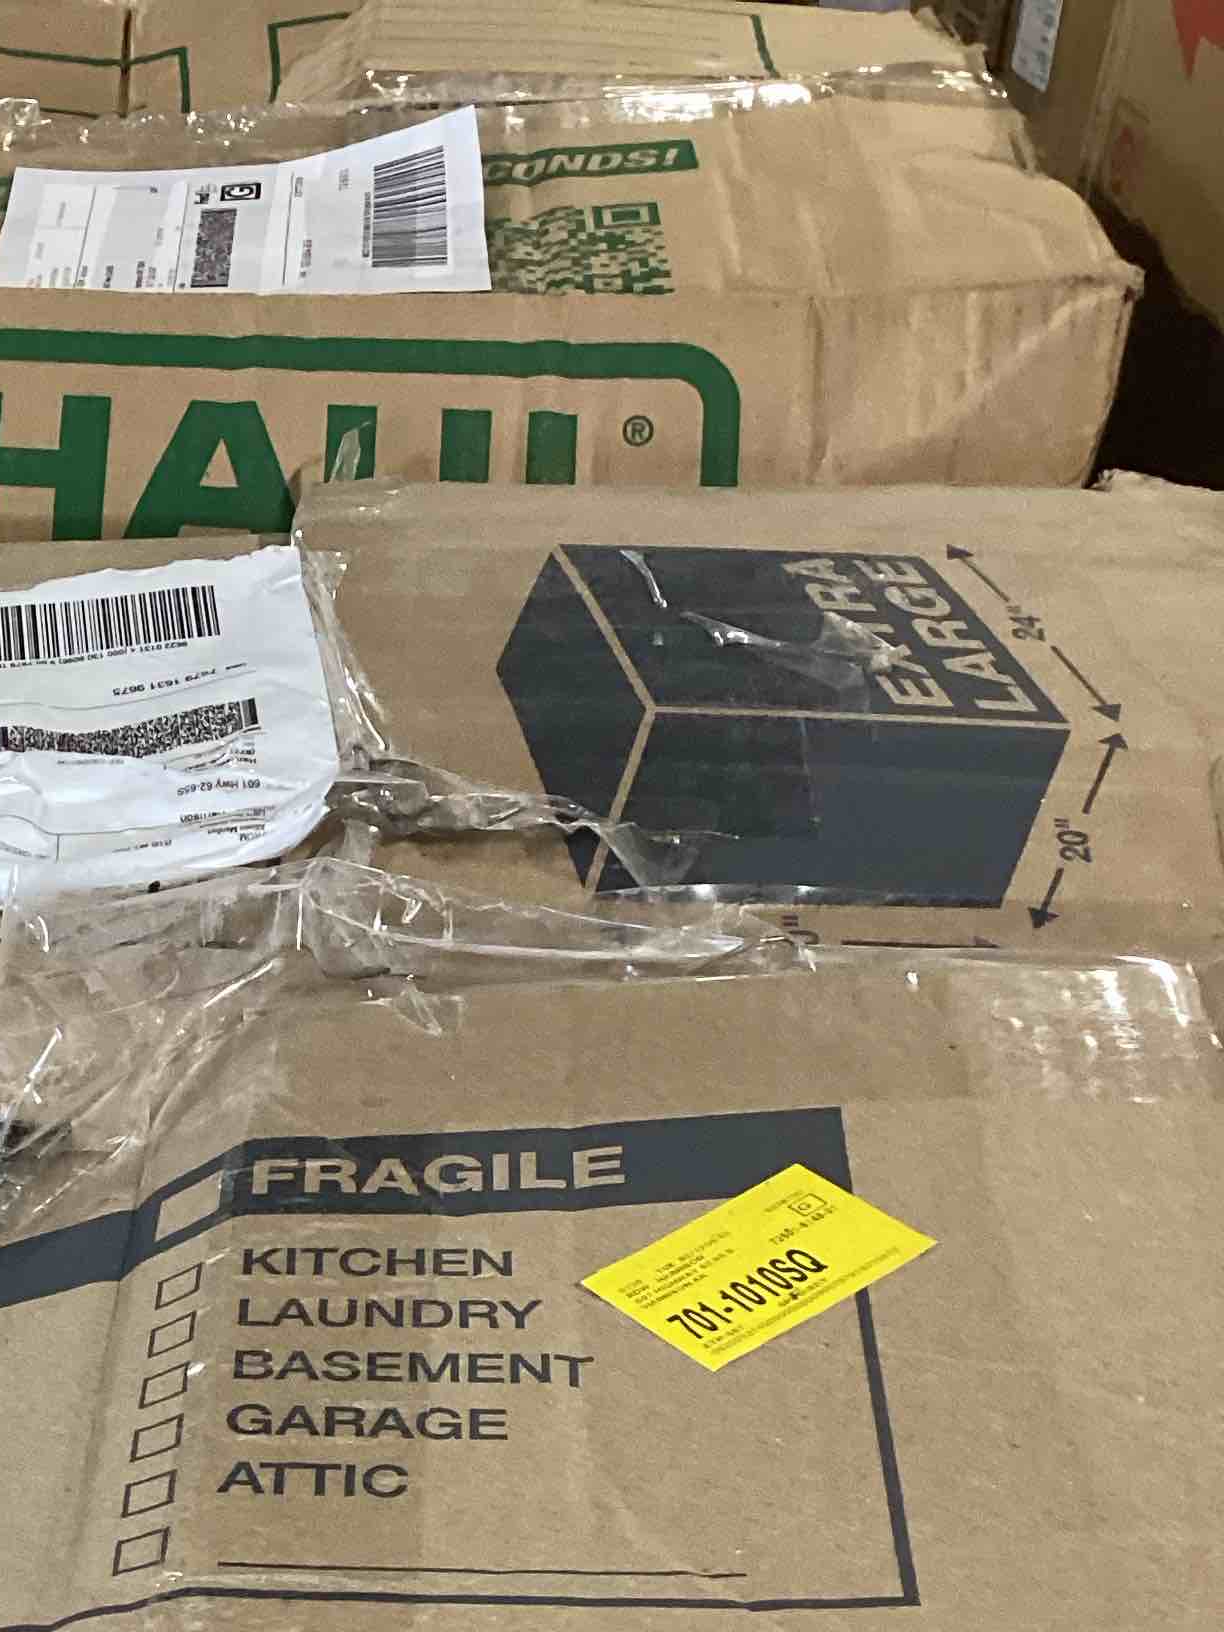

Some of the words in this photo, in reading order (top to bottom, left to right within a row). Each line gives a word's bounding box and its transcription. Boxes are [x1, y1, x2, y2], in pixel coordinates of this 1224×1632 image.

[856, 557, 1040, 713] LARGE
[1006, 604, 1047, 642] 24"
[1054, 816, 1093, 864] 20"
[250, 1145, 626, 1196] FRAGILE
[241, 1247, 514, 1278] KITCHEN
[237, 1298, 543, 1329] LAUNDRY
[666, 1248, 830, 1340] 701-1010SQ
[232, 1348, 595, 1389] BASEMENT
[225, 1403, 509, 1441] GARAGE
[216, 1460, 409, 1499] ATTIC
